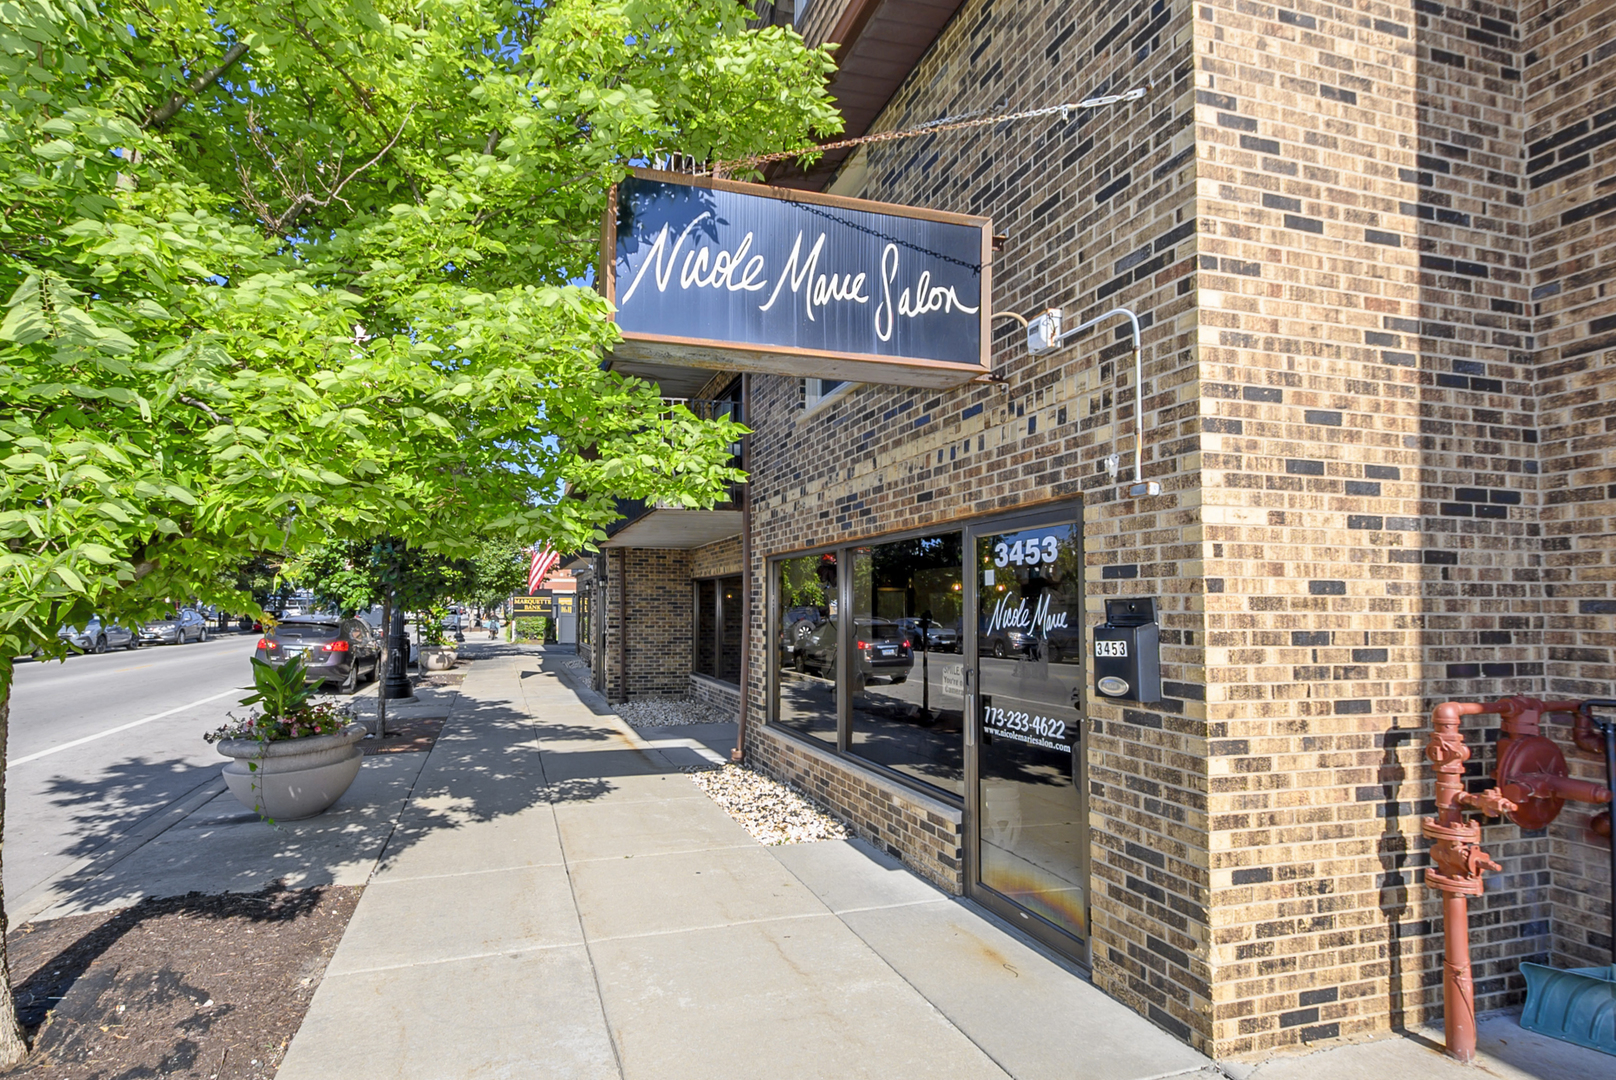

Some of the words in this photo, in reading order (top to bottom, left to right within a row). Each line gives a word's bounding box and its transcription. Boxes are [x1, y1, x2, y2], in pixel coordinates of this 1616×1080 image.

[621, 211, 768, 305] Nicole
[759, 229, 869, 321] Marie
[874, 243, 979, 342] Salon
[994, 535, 1058, 568] 3453
[986, 591, 1030, 637] Nicole
[1027, 593, 1068, 640] Marie
[1096, 642, 1126, 656] 3453
[983, 726, 1071, 753] www.nicolemariesalon.com
[984, 705, 1066, 740] 773-233-4622
